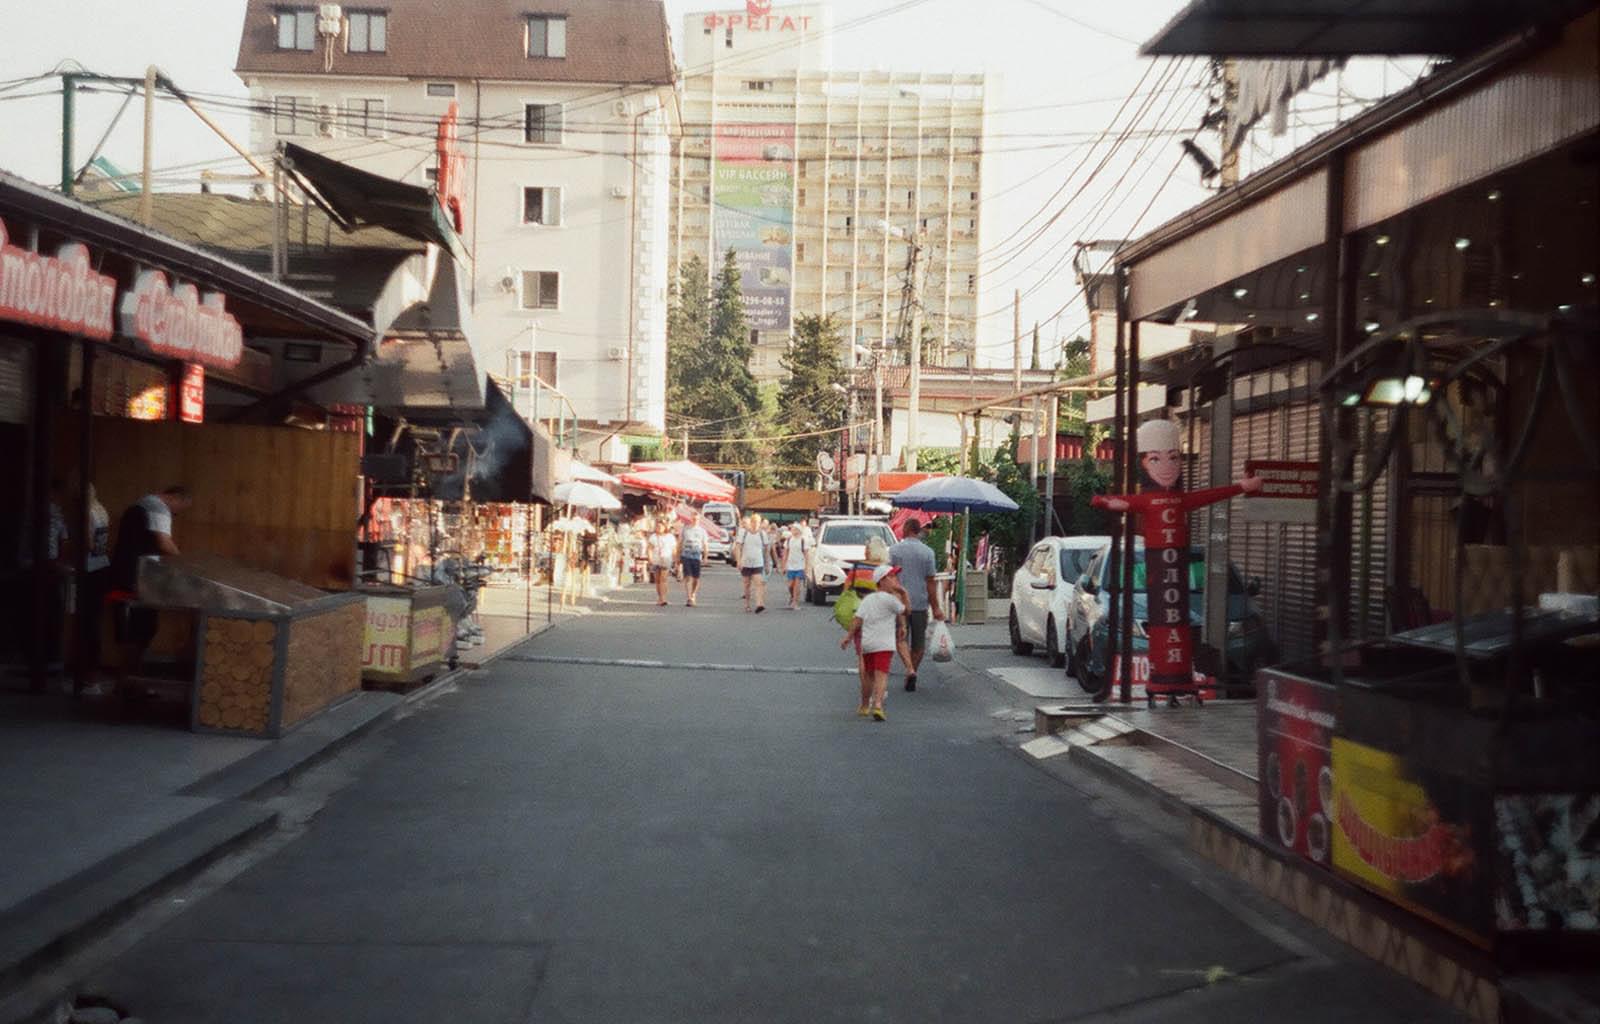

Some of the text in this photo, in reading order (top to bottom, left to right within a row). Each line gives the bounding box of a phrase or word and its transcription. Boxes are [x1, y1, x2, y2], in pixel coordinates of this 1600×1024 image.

[703, 11, 812, 32] ФРЕГАТ
[718, 168, 787, 181] VIP БАССЕЙН
[1160, 507, 1184, 664] СТОЛОВАЯ
